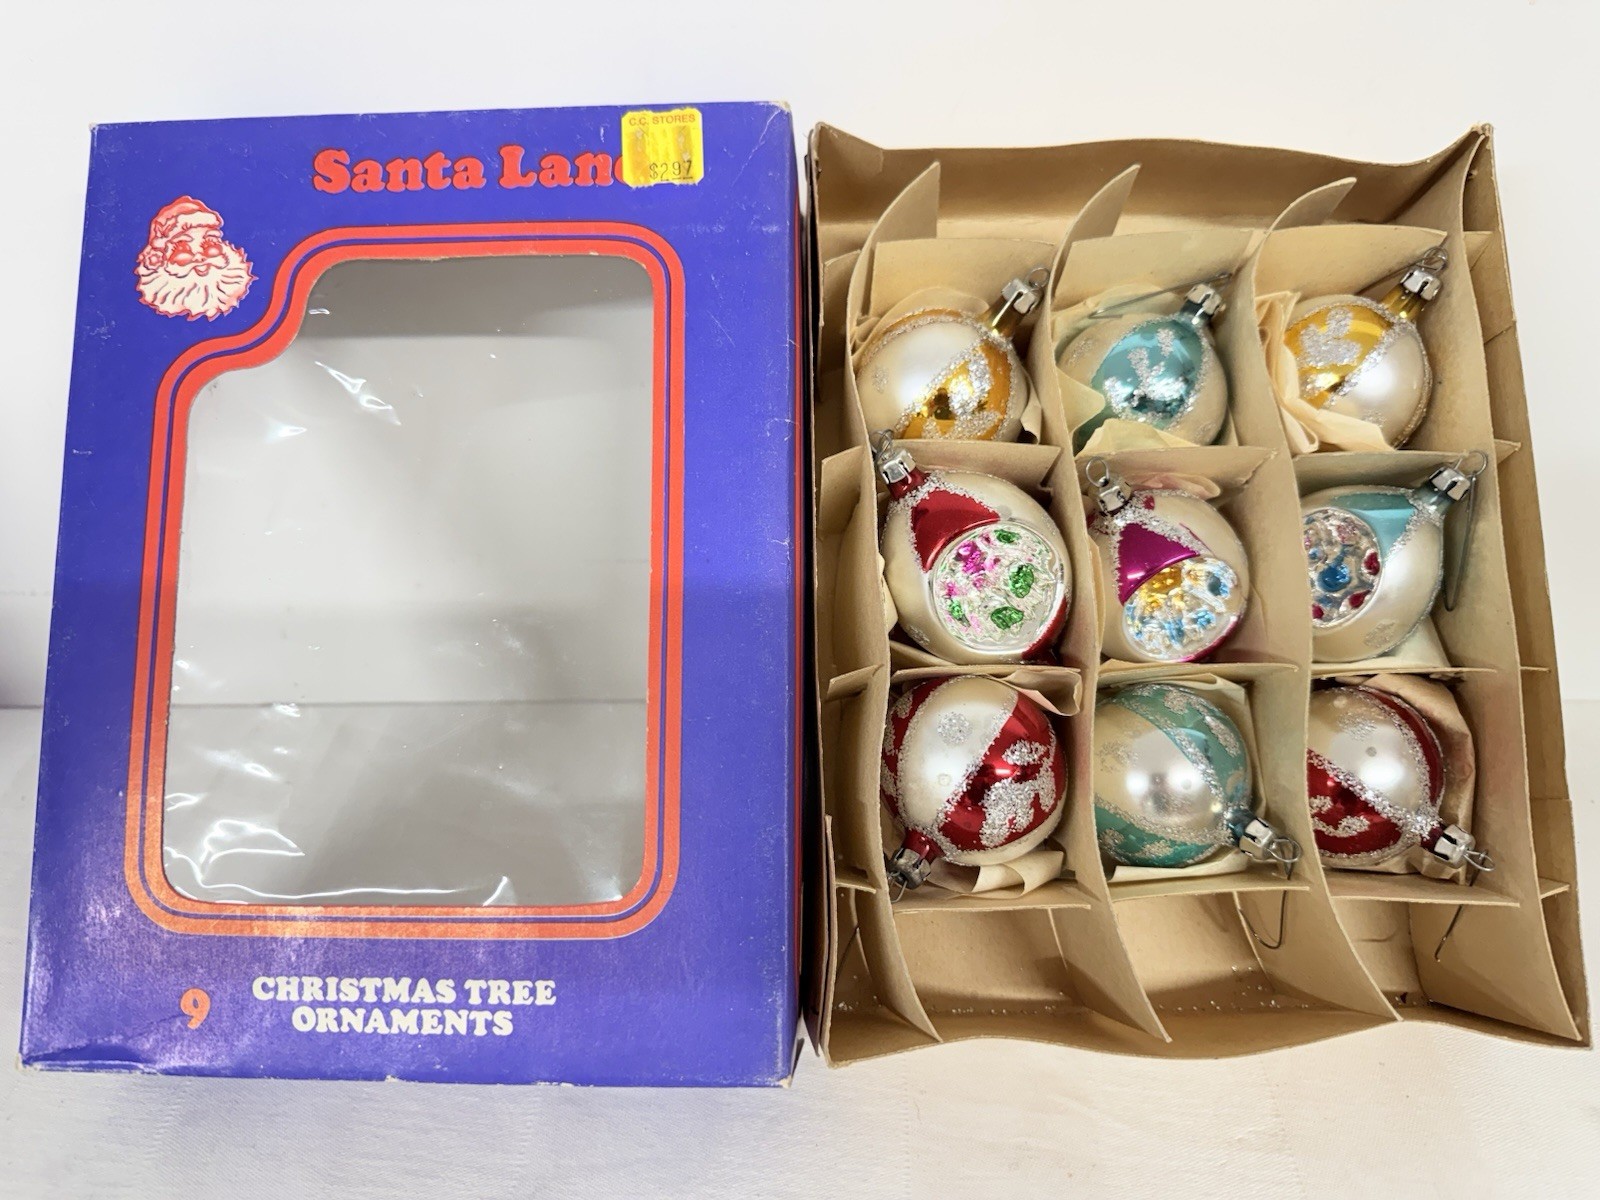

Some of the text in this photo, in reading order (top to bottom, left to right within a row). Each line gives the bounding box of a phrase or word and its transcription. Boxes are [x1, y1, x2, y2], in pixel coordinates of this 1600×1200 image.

[652, 113, 696, 125] STORES
[313, 149, 487, 195] Santa
[252, 976, 557, 1006] CHRISTMAS TREE
[180, 988, 211, 1030] 9
[291, 1006, 514, 1036] ORNAMENTS
